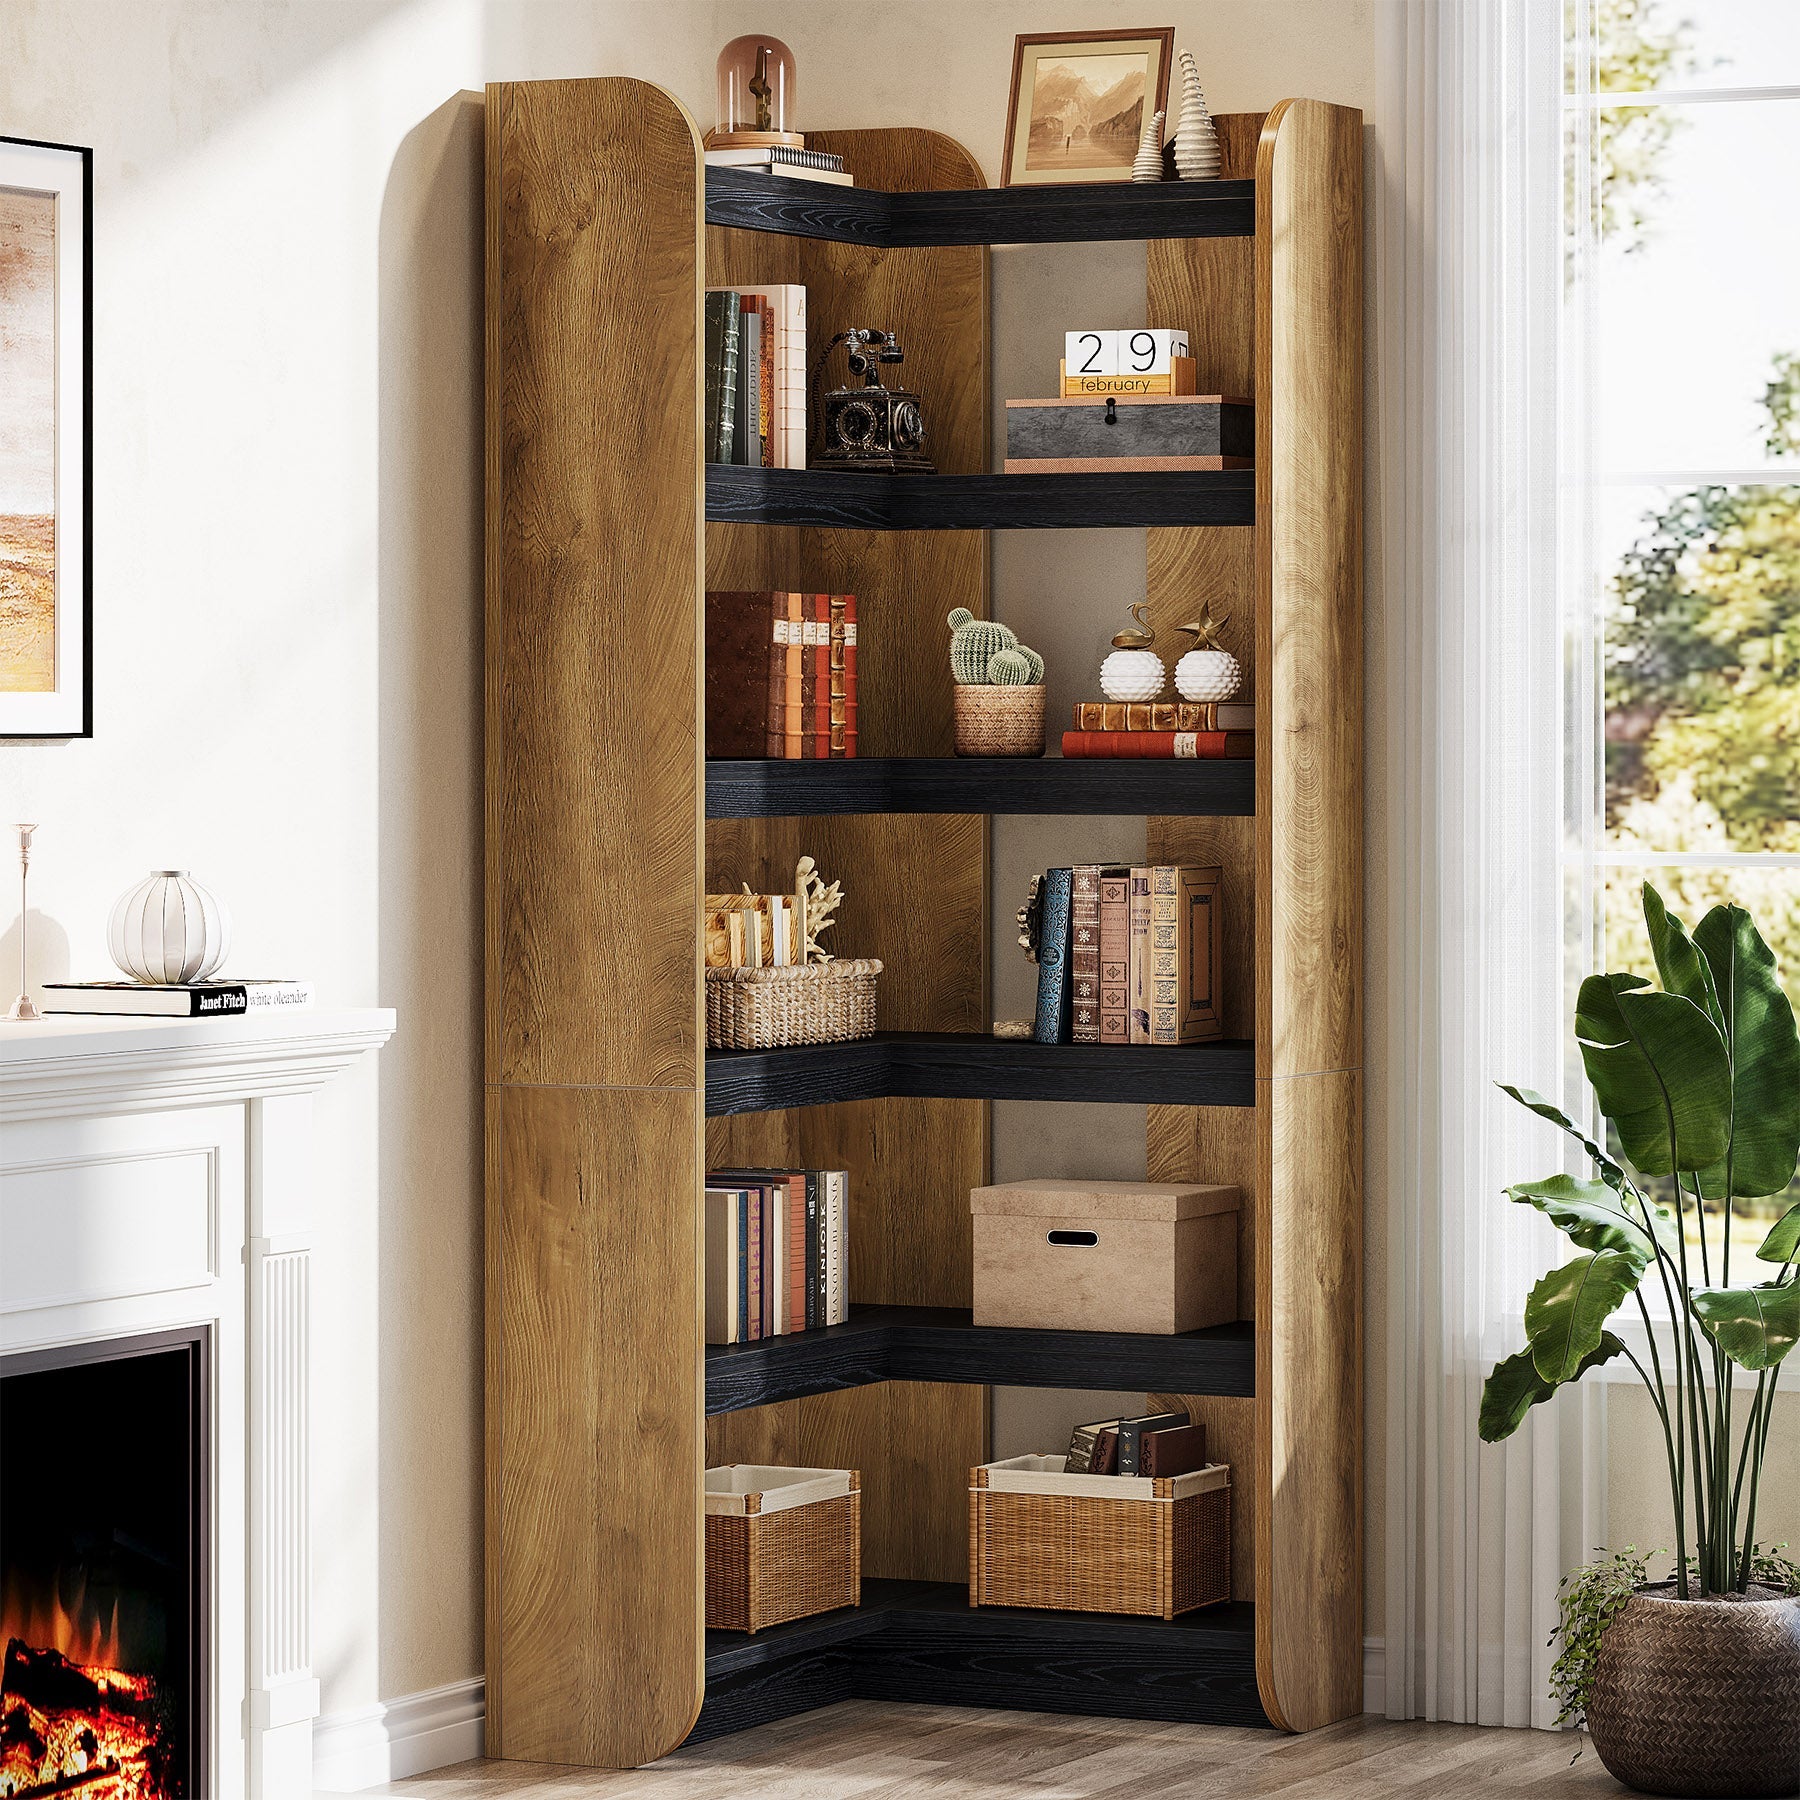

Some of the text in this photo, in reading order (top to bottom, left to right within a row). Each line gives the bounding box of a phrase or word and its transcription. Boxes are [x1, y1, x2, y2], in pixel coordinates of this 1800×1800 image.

[1080, 377, 1151, 394] february
[200, 992, 246, 1010] Janet Fitch
[273, 990, 308, 1005] oleander
